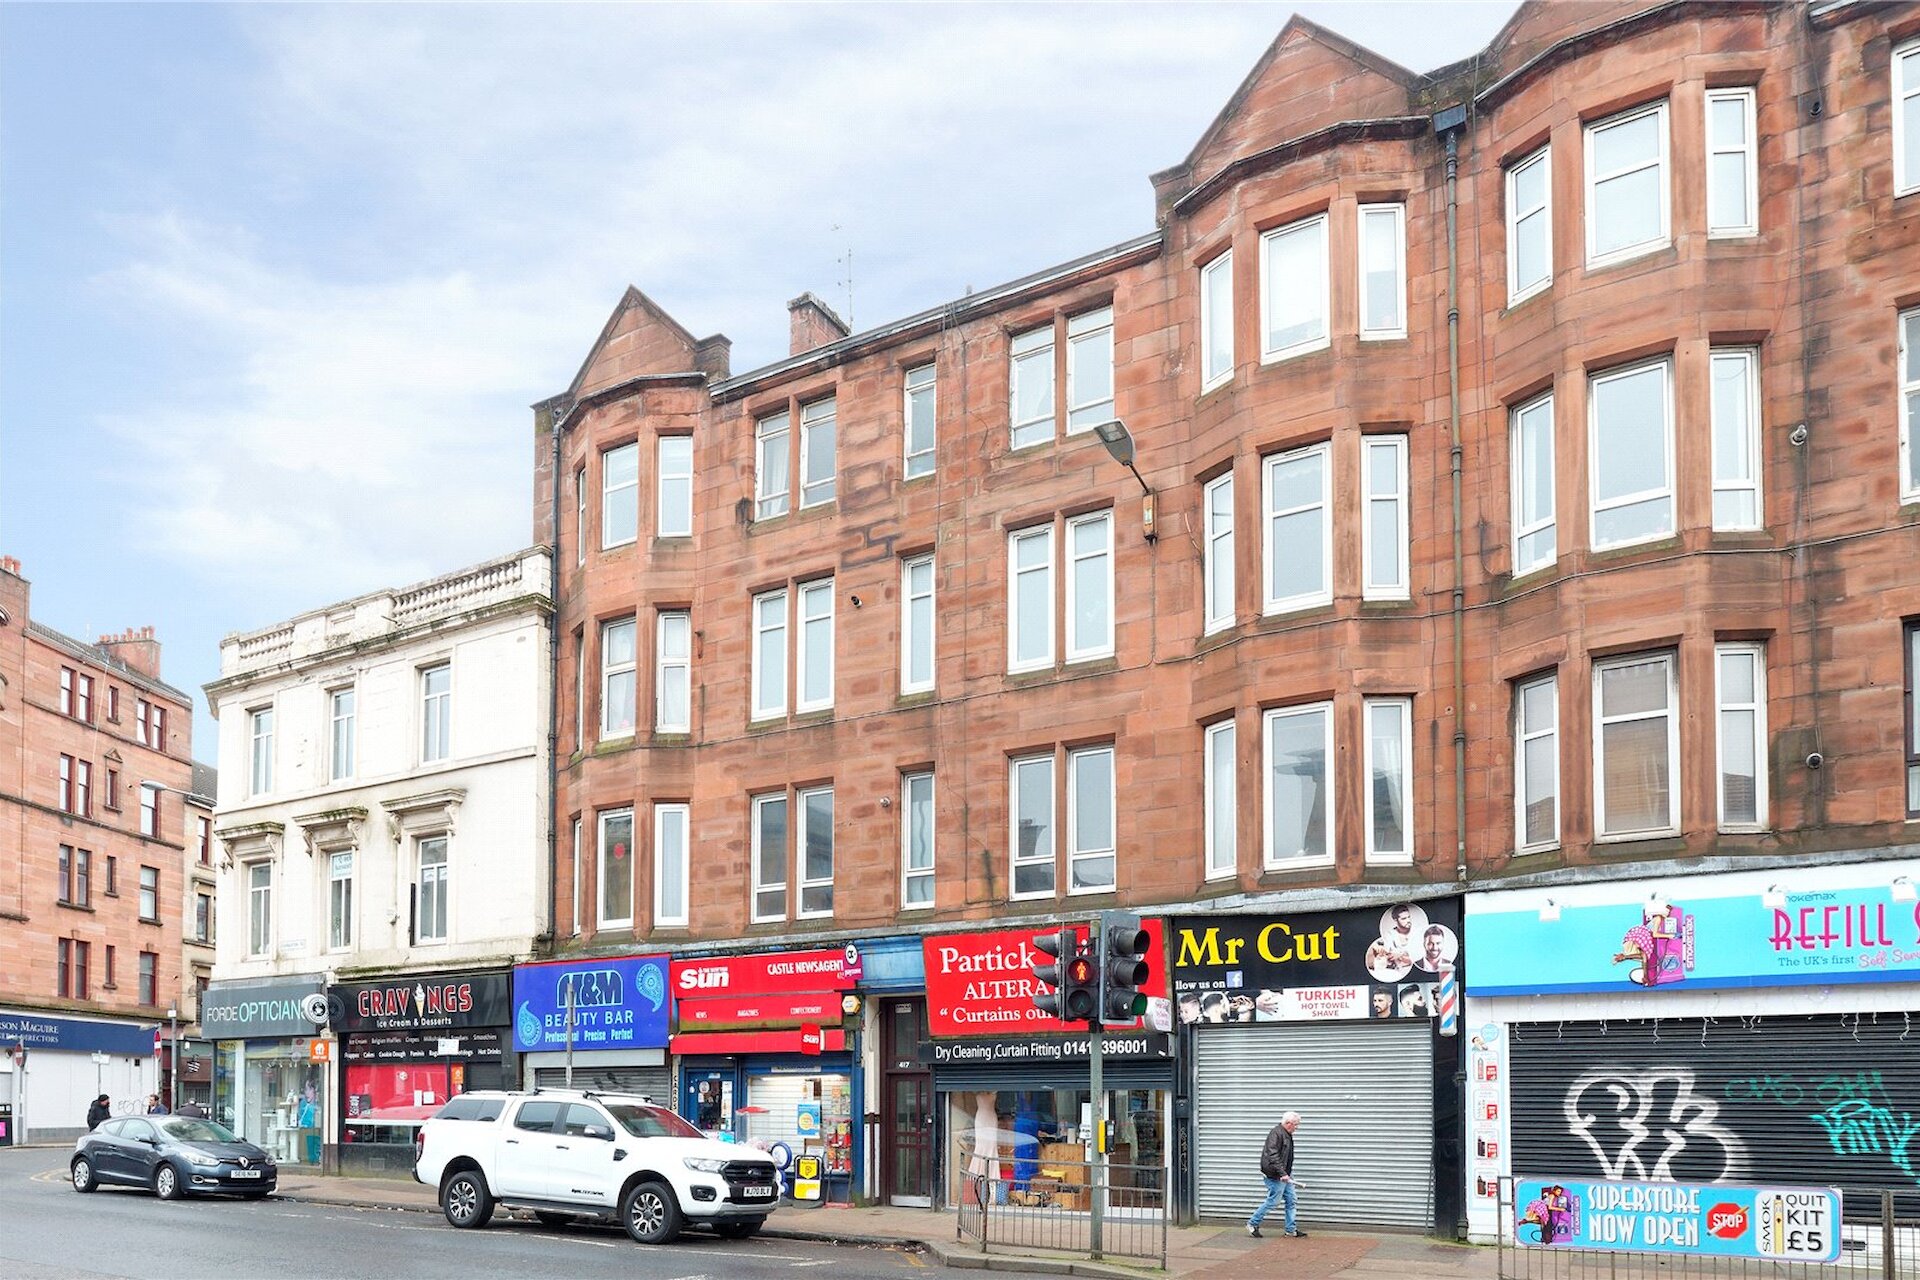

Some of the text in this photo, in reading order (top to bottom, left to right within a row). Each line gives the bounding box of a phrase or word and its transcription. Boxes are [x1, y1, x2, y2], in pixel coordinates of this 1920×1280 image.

[1768, 903, 1893, 951] REFILL
[1176, 922, 1341, 967] Mr Cut
[939, 941, 1036, 973] Partick
[1778, 957, 1800, 967] The
[1803, 956, 1829, 966] UK's
[1831, 955, 1854, 965] first
[766, 961, 794, 975] CASTLE
[679, 967, 730, 990] Sun
[1199, 981, 1210, 989] us
[1212, 981, 1226, 989] on
[557, 970, 623, 1008] M&M
[964, 980, 1052, 1000] ALTERA
[1295, 989, 1356, 1001] TURKISH
[207, 1006, 238, 1022] FORDE
[604, 1010, 634, 1025] BAR
[953, 1006, 1021, 1023] Curtains
[1025, 1008, 1053, 1020] ou
[1312, 1009, 1339, 1017] SHAVE
[0, 1022, 18, 1030] SON
[389, 1018, 411, 1027] Cream
[420, 1017, 452, 1026] Desserts
[545, 1031, 580, 1043] Professnal
[935, 1045, 951, 1061] Dry
[953, 1044, 991, 1061] Cleaning
[1031, 1042, 1061, 1059] Fitting
[1587, 1184, 1702, 1214] SUPERSTORE
[1786, 1194, 1826, 1208] QUIT
[1712, 1212, 1744, 1228] STOP
[1762, 1198, 1771, 1252] SMOK
[1787, 1210, 1824, 1226] KIT
[1589, 1213, 1700, 1247] NOW OPEN
[1787, 1230, 1824, 1252] £5
